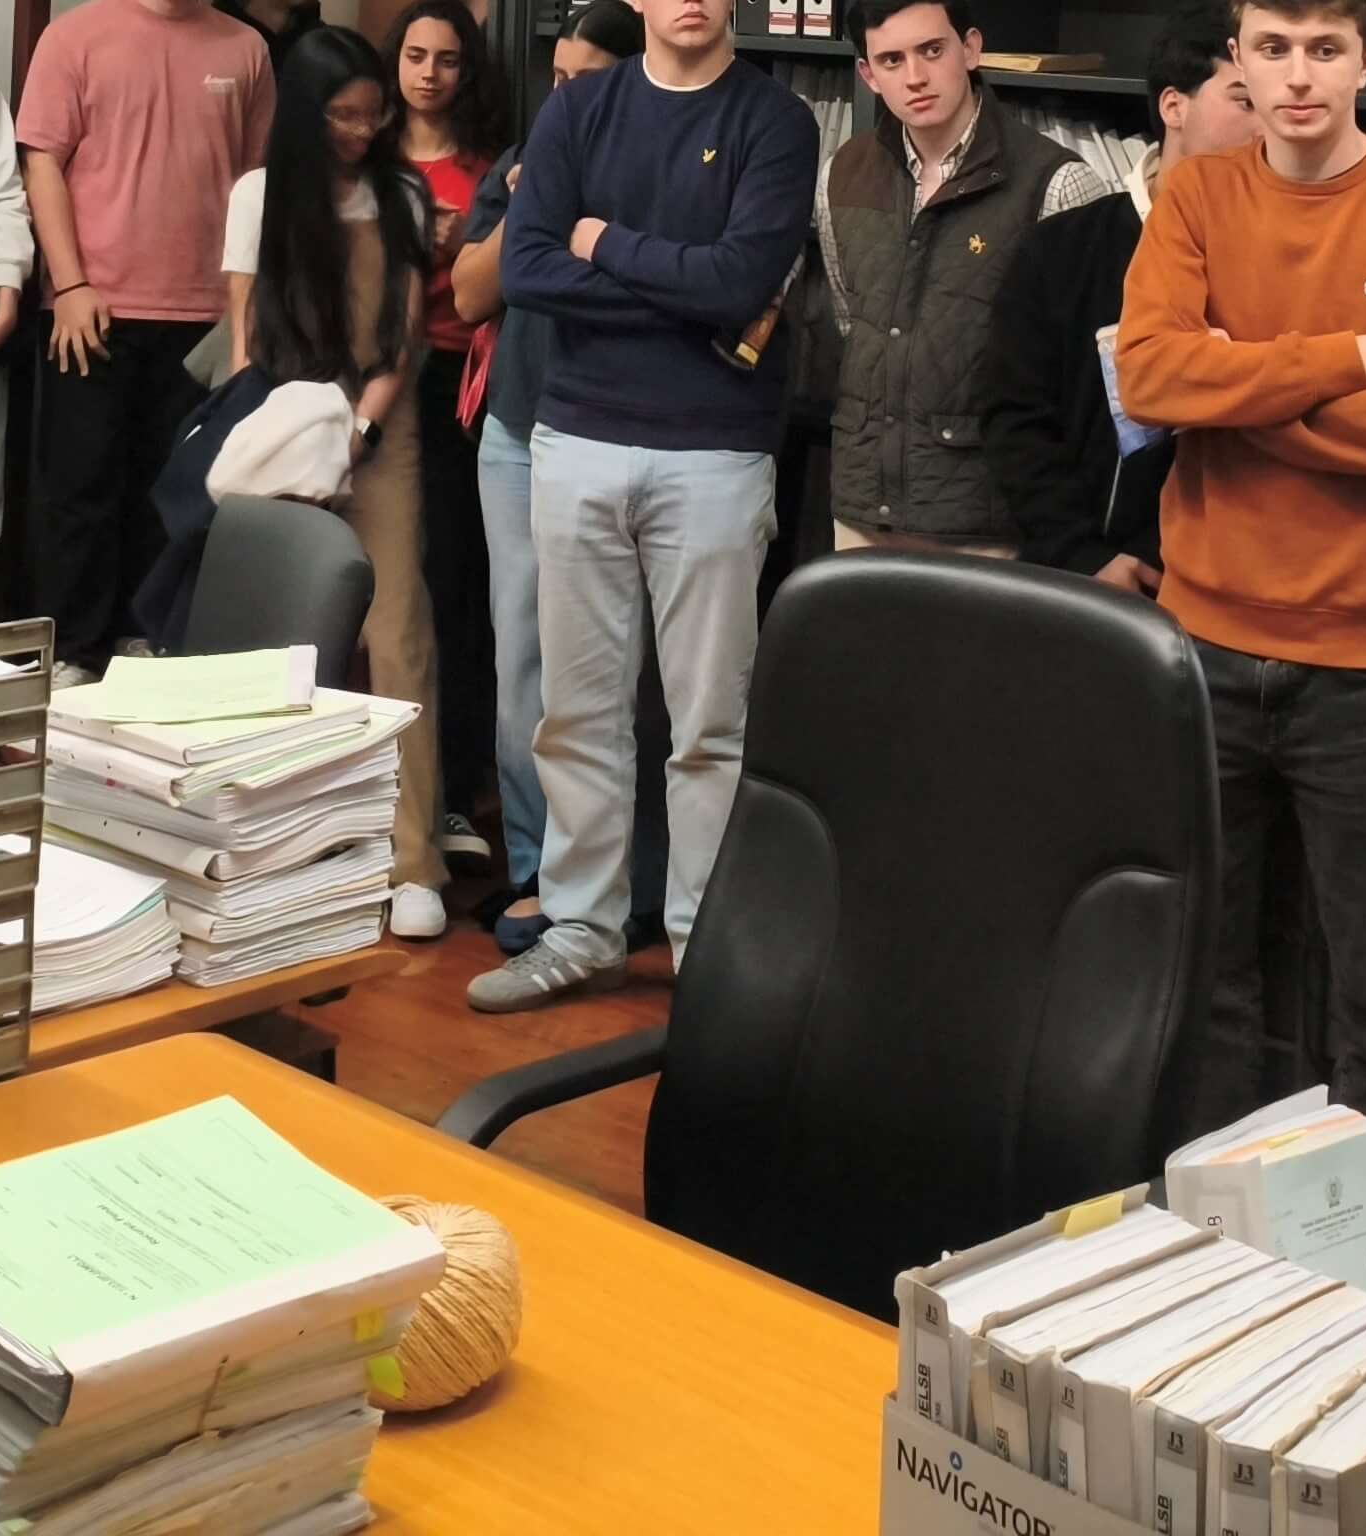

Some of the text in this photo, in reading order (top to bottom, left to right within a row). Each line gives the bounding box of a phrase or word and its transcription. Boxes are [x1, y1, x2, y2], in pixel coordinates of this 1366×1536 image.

[998, 1368, 1016, 1390] J3
[1167, 1431, 1185, 1452] J3
[1233, 1463, 1255, 1485] J3
[897, 1437, 1051, 1536] NAVIGATOR
[1300, 1482, 1324, 1505] J3
